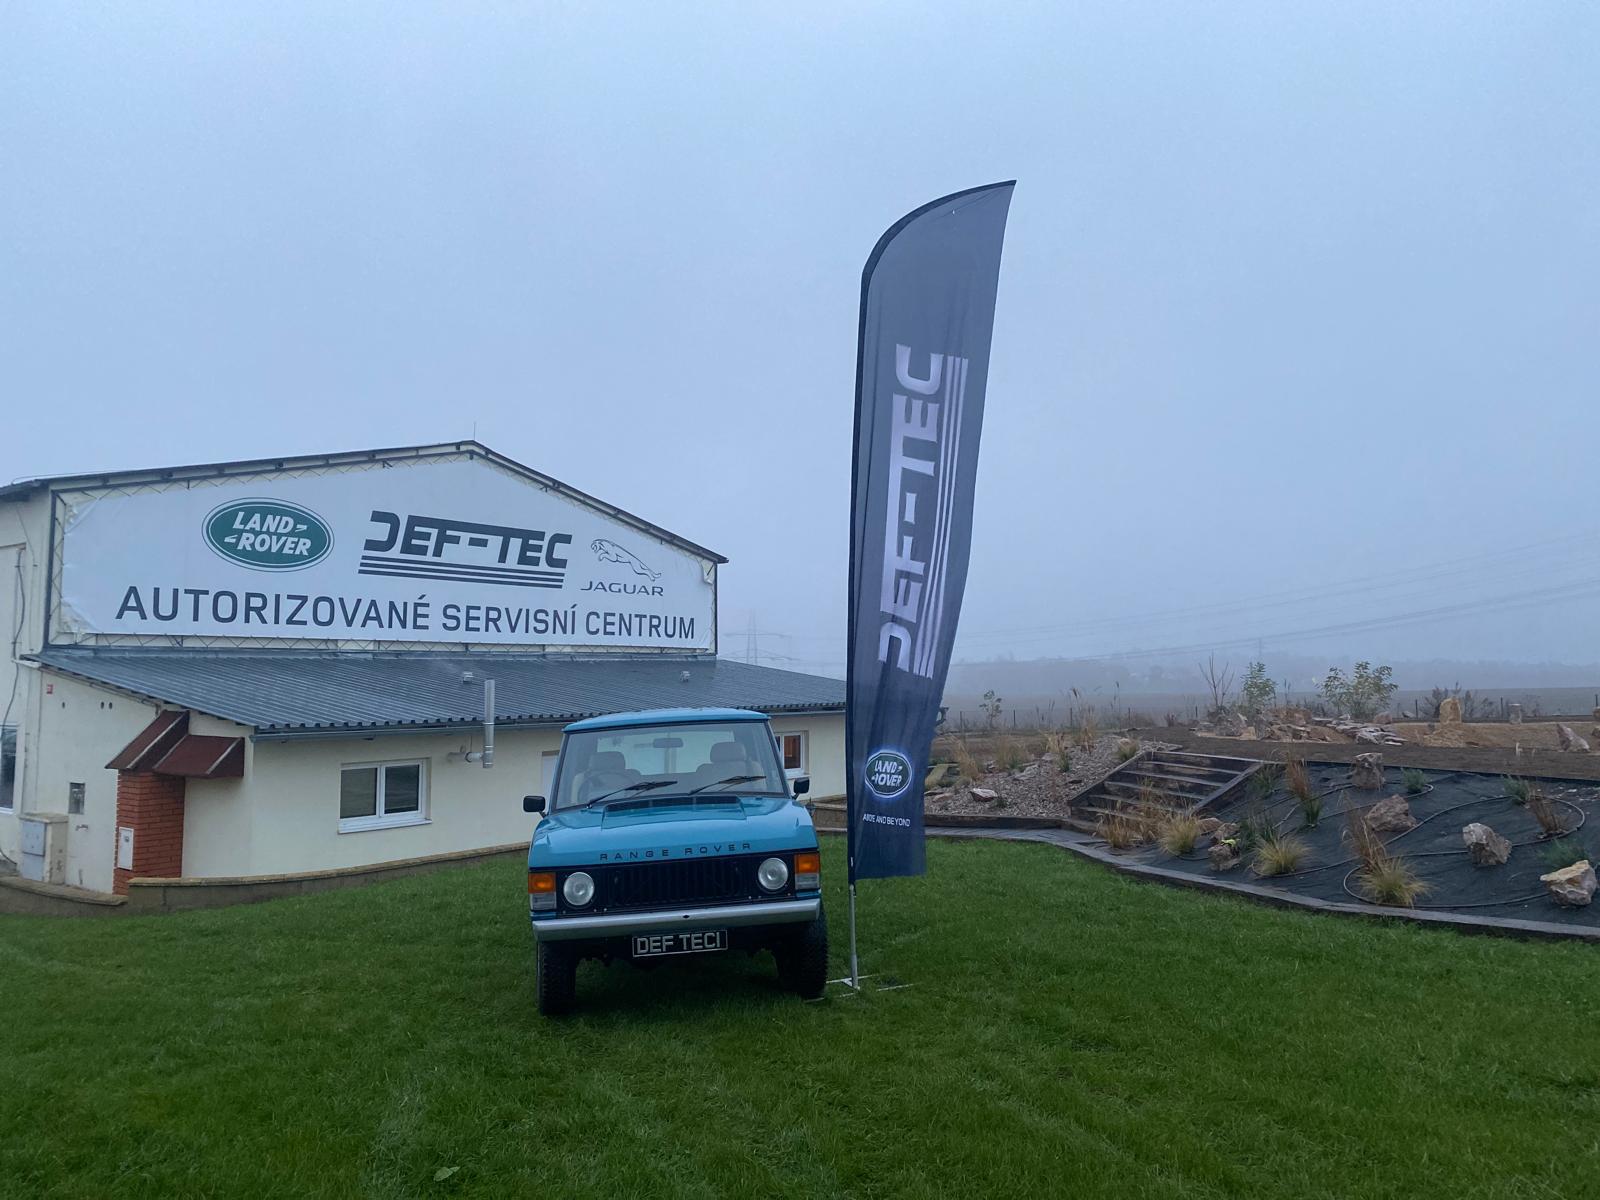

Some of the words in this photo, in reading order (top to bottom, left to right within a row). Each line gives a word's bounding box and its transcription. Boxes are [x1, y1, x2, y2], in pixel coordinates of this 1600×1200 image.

[233, 511, 294, 534] LAND
[237, 533, 312, 556] ROVER
[363, 510, 572, 569] DEF-TEC
[580, 581, 664, 597] JAGUAR
[115, 585, 431, 631] AUTORIZOVANÉ
[442, 603, 578, 635] SERVISNÍ
[585, 611, 695, 640] CENTRUM
[874, 760, 898, 774] LAND
[886, 816, 911, 827] BEYOND
[600, 849, 669, 861] RANGE
[684, 843, 751, 856] ROVER
[636, 935, 674, 954] DEF
